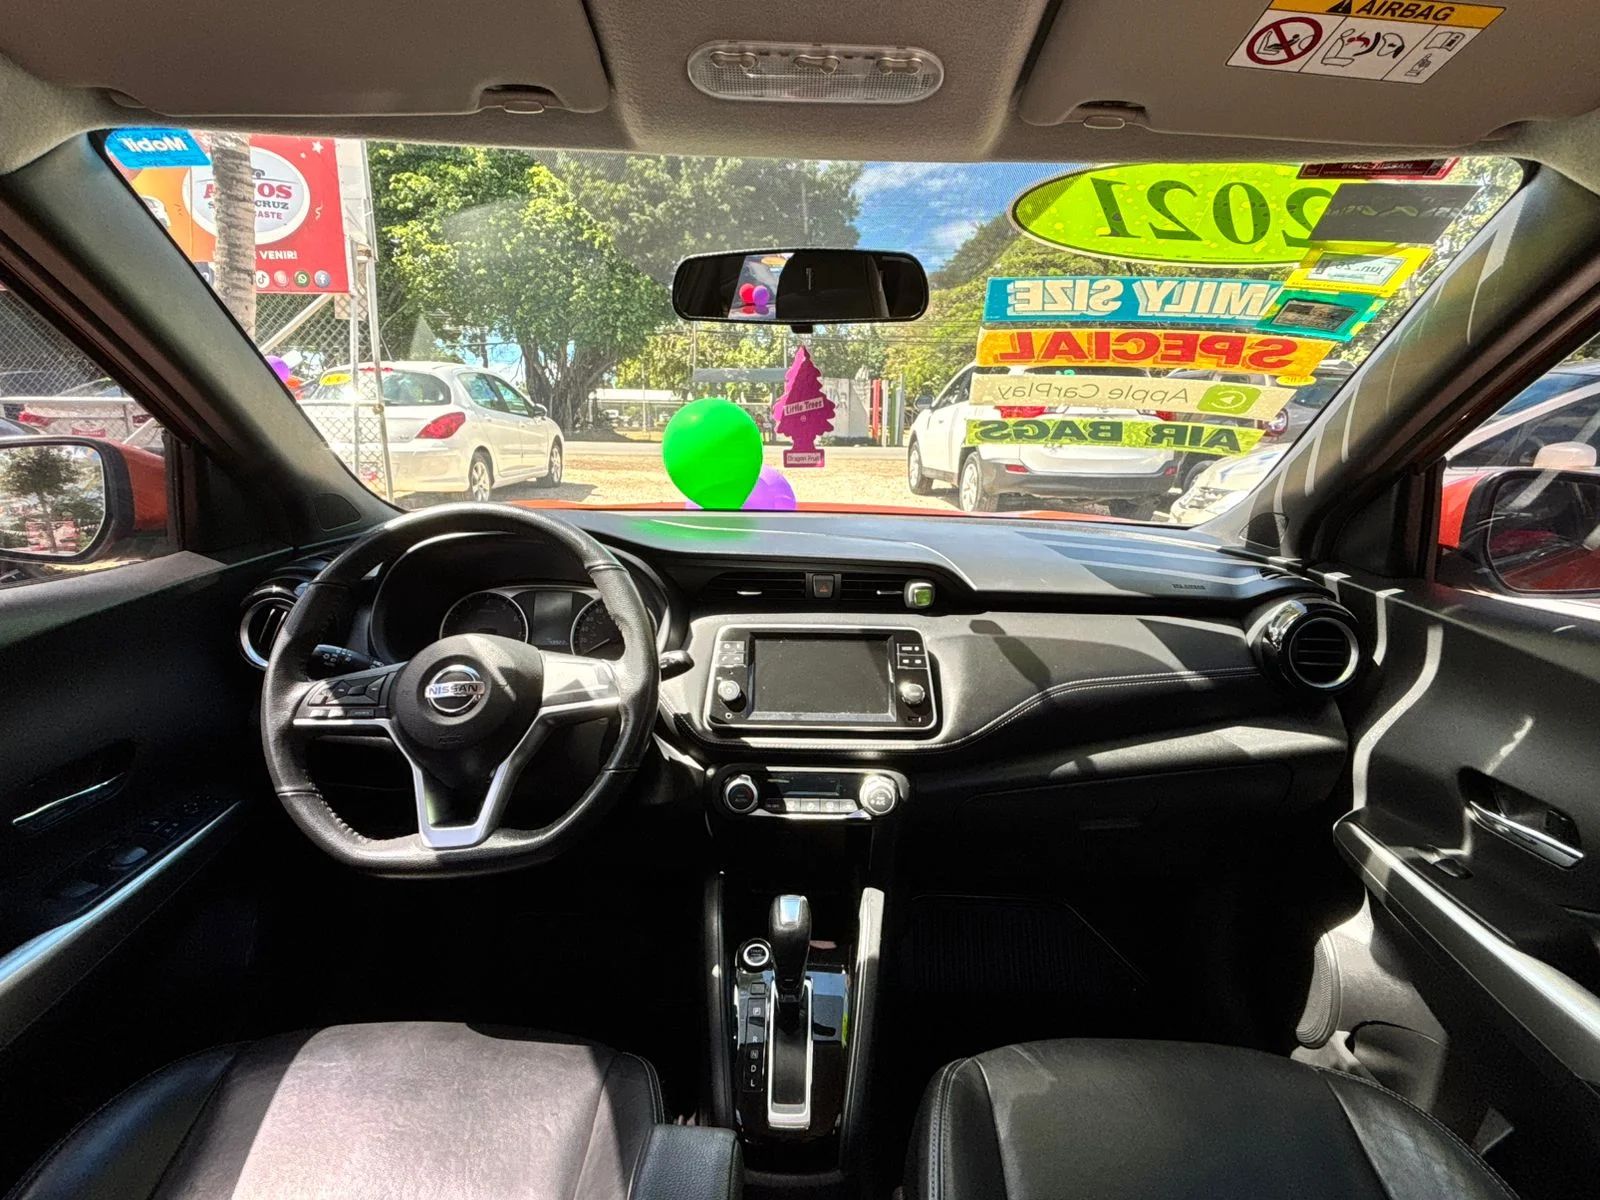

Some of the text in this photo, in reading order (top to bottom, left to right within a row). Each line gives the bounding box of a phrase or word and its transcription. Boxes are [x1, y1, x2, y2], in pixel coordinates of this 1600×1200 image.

[1356, 0, 1456, 21] AIRBAG
[254, 199, 289, 210] CRUZ
[785, 403, 803, 415] Little
[804, 400, 823, 410] Trees
[428, 684, 479, 696] NISSAN
[750, 1064, 757, 1073] D
[750, 1079, 756, 1087] L
